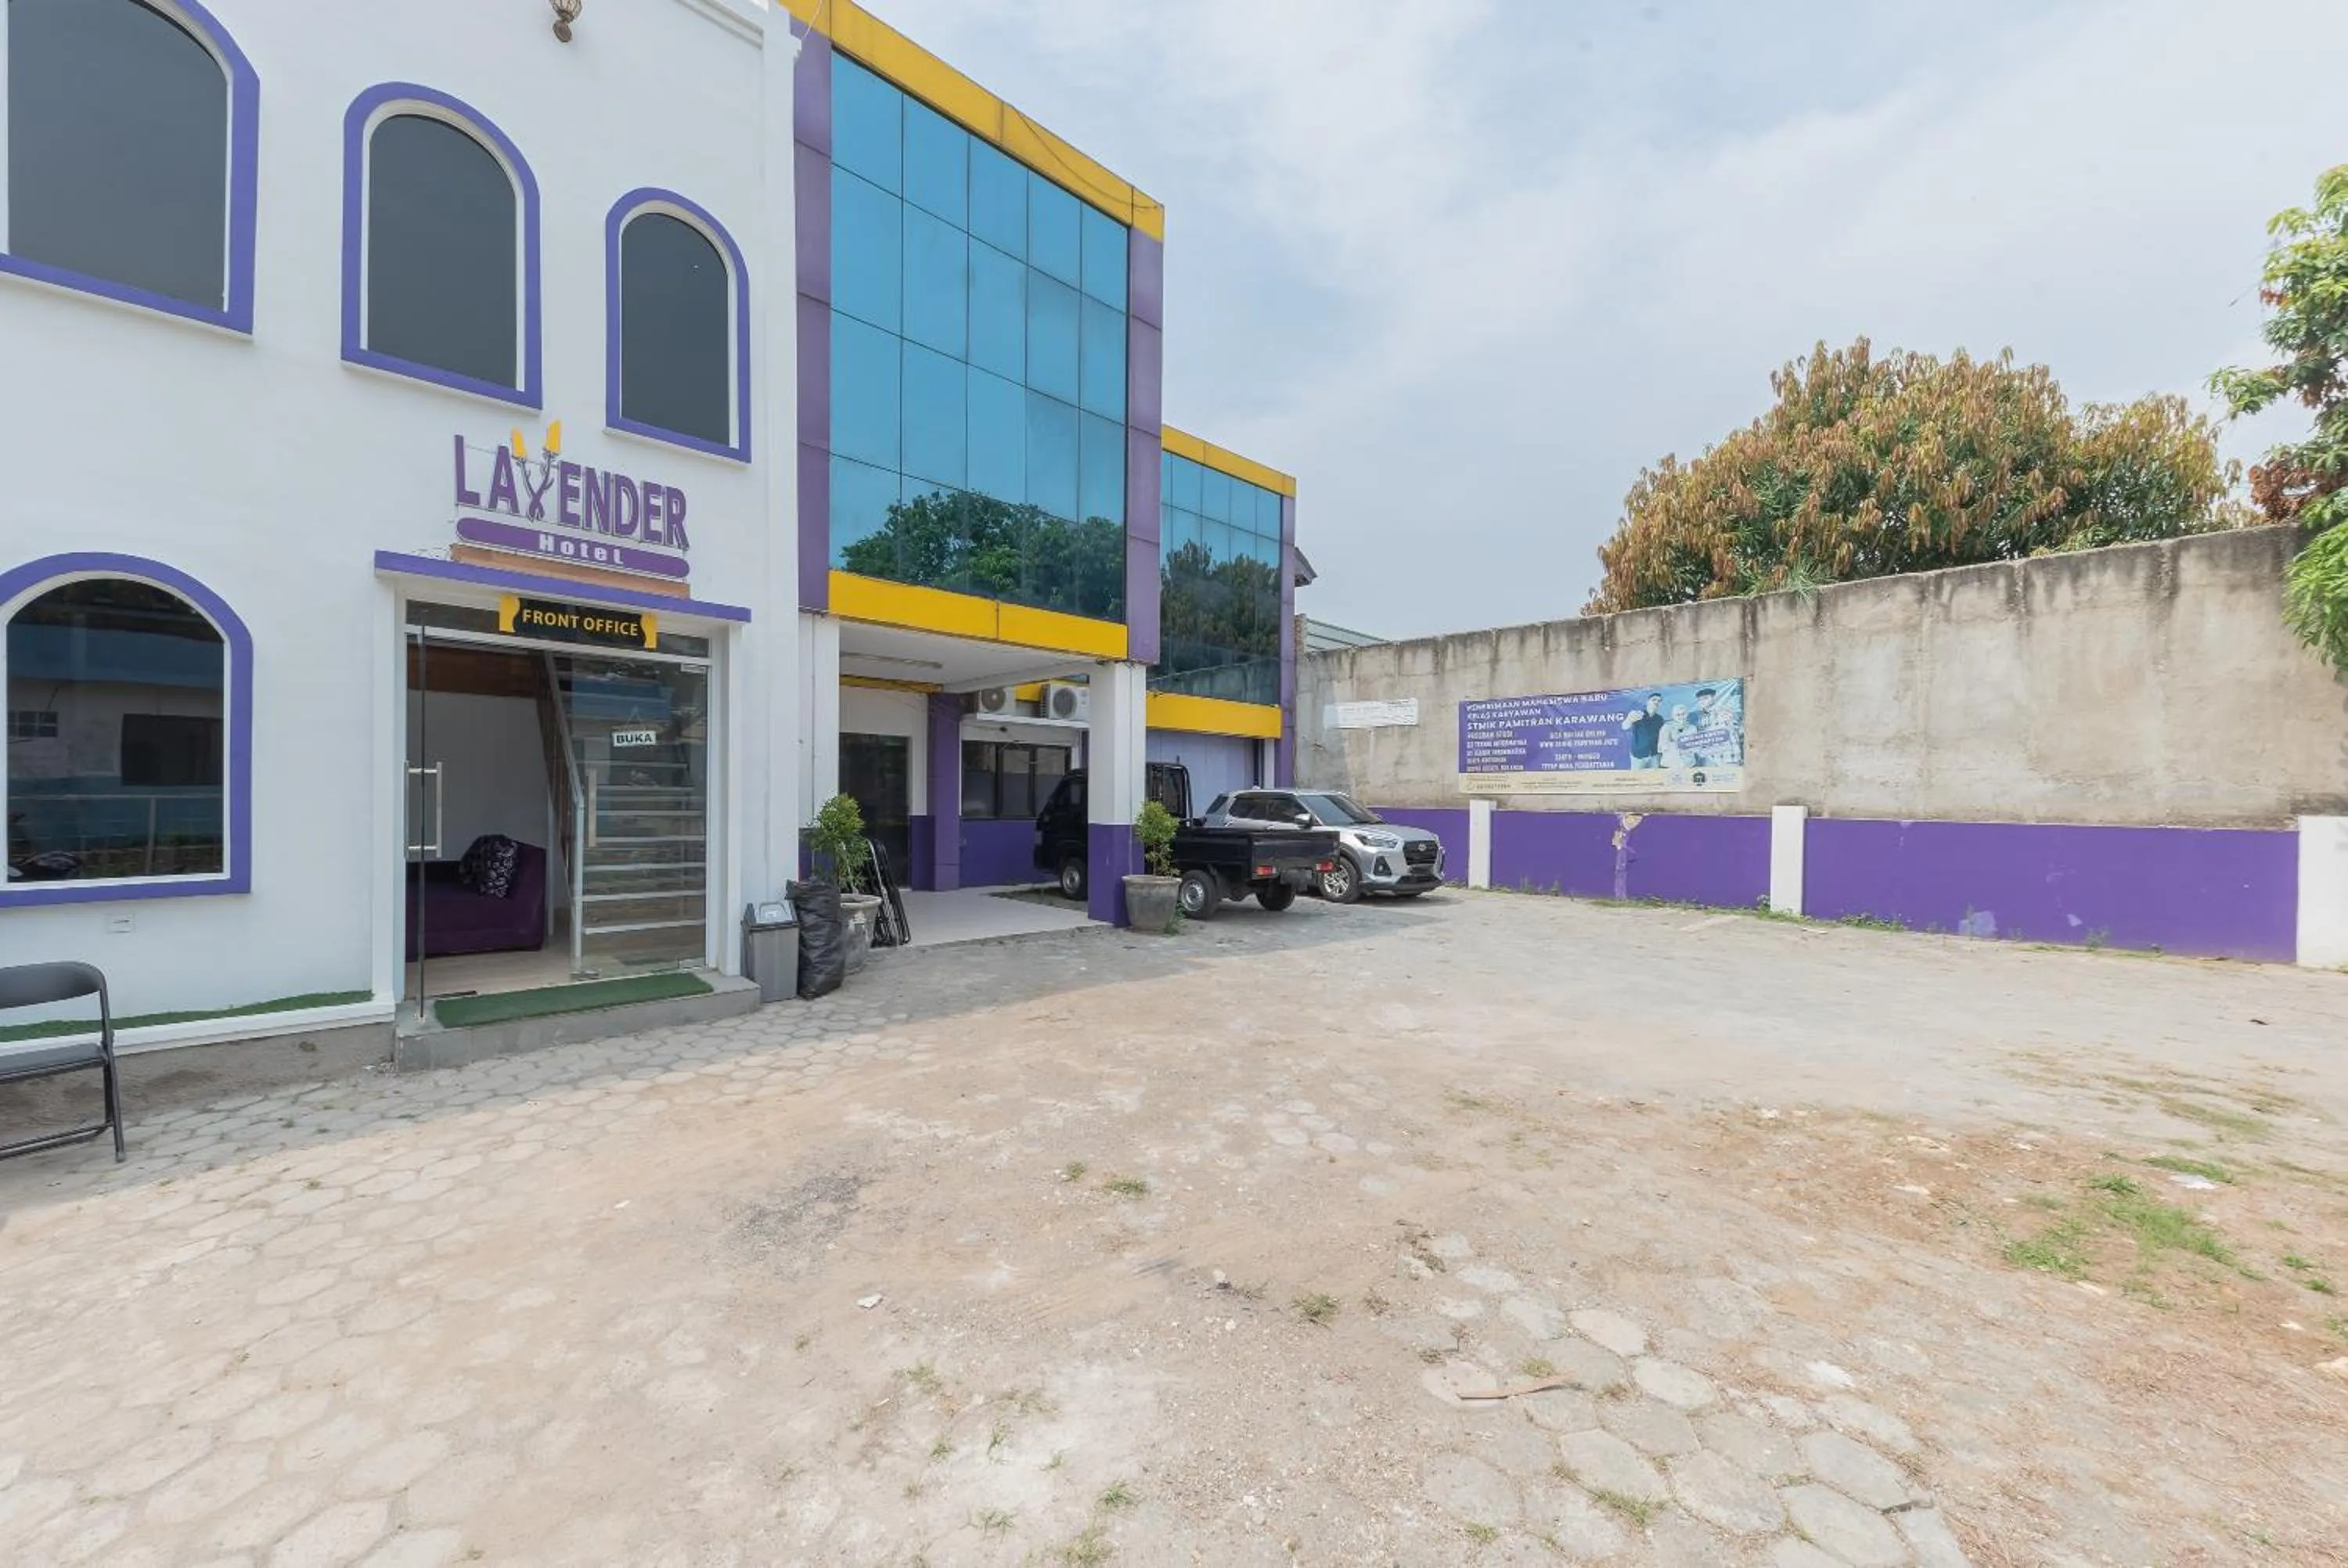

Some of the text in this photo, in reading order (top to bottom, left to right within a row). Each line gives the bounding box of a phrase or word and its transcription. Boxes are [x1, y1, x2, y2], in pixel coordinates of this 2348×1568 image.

[522, 609, 639, 636] FRONT OFFICE
[1522, 696, 1579, 706] MAHASISWA
[1493, 708, 1541, 717] KARYAWAN
[1468, 713, 1624, 730] STMIK PAMITRAN KARAWANG
[616, 733, 652, 743] BUKA
